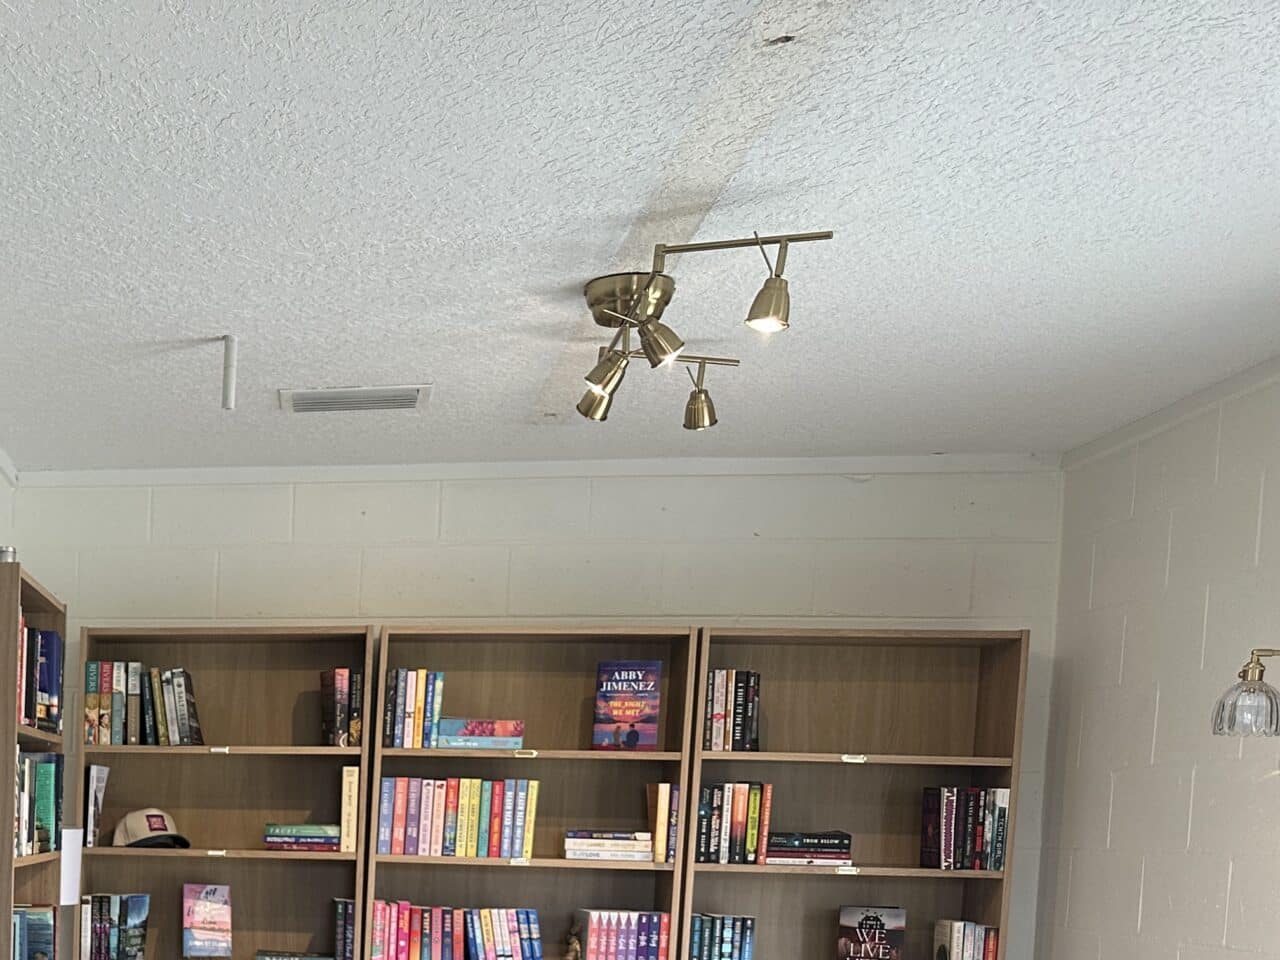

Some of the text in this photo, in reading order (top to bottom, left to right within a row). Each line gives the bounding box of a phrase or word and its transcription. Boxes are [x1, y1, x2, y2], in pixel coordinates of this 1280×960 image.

[612, 670, 646, 681] ABBY
[600, 681, 656, 692] JIMENEZ
[856, 928, 887, 944] WE
[850, 943, 891, 959] LIVE
